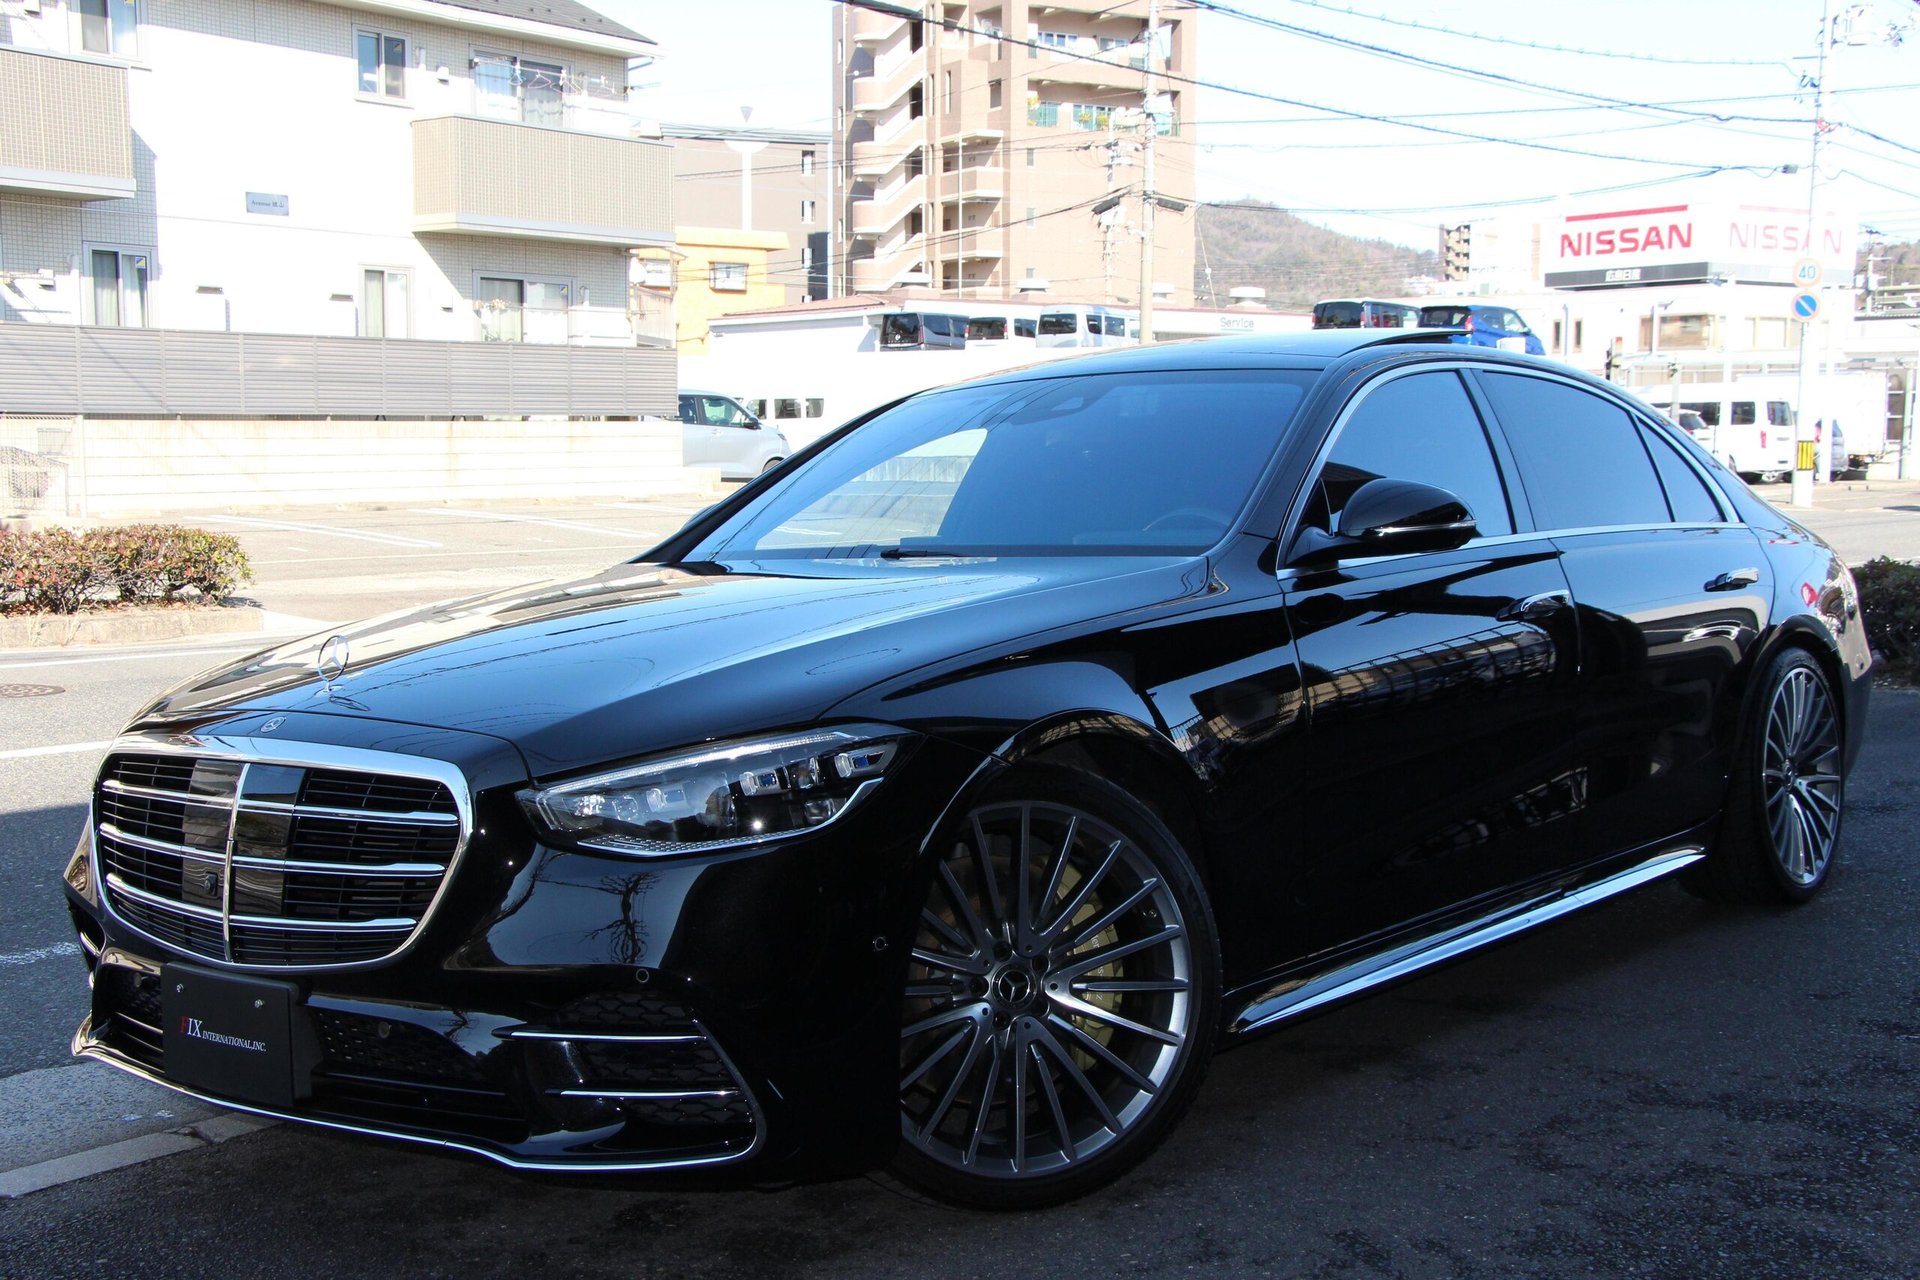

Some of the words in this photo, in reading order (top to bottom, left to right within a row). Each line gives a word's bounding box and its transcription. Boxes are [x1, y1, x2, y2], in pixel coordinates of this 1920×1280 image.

[1560, 222, 1693, 258] NISSAN
[1798, 265, 1816, 279] 40
[1220, 316, 1254, 328] Service
[180, 1015, 203, 1038] FIX
